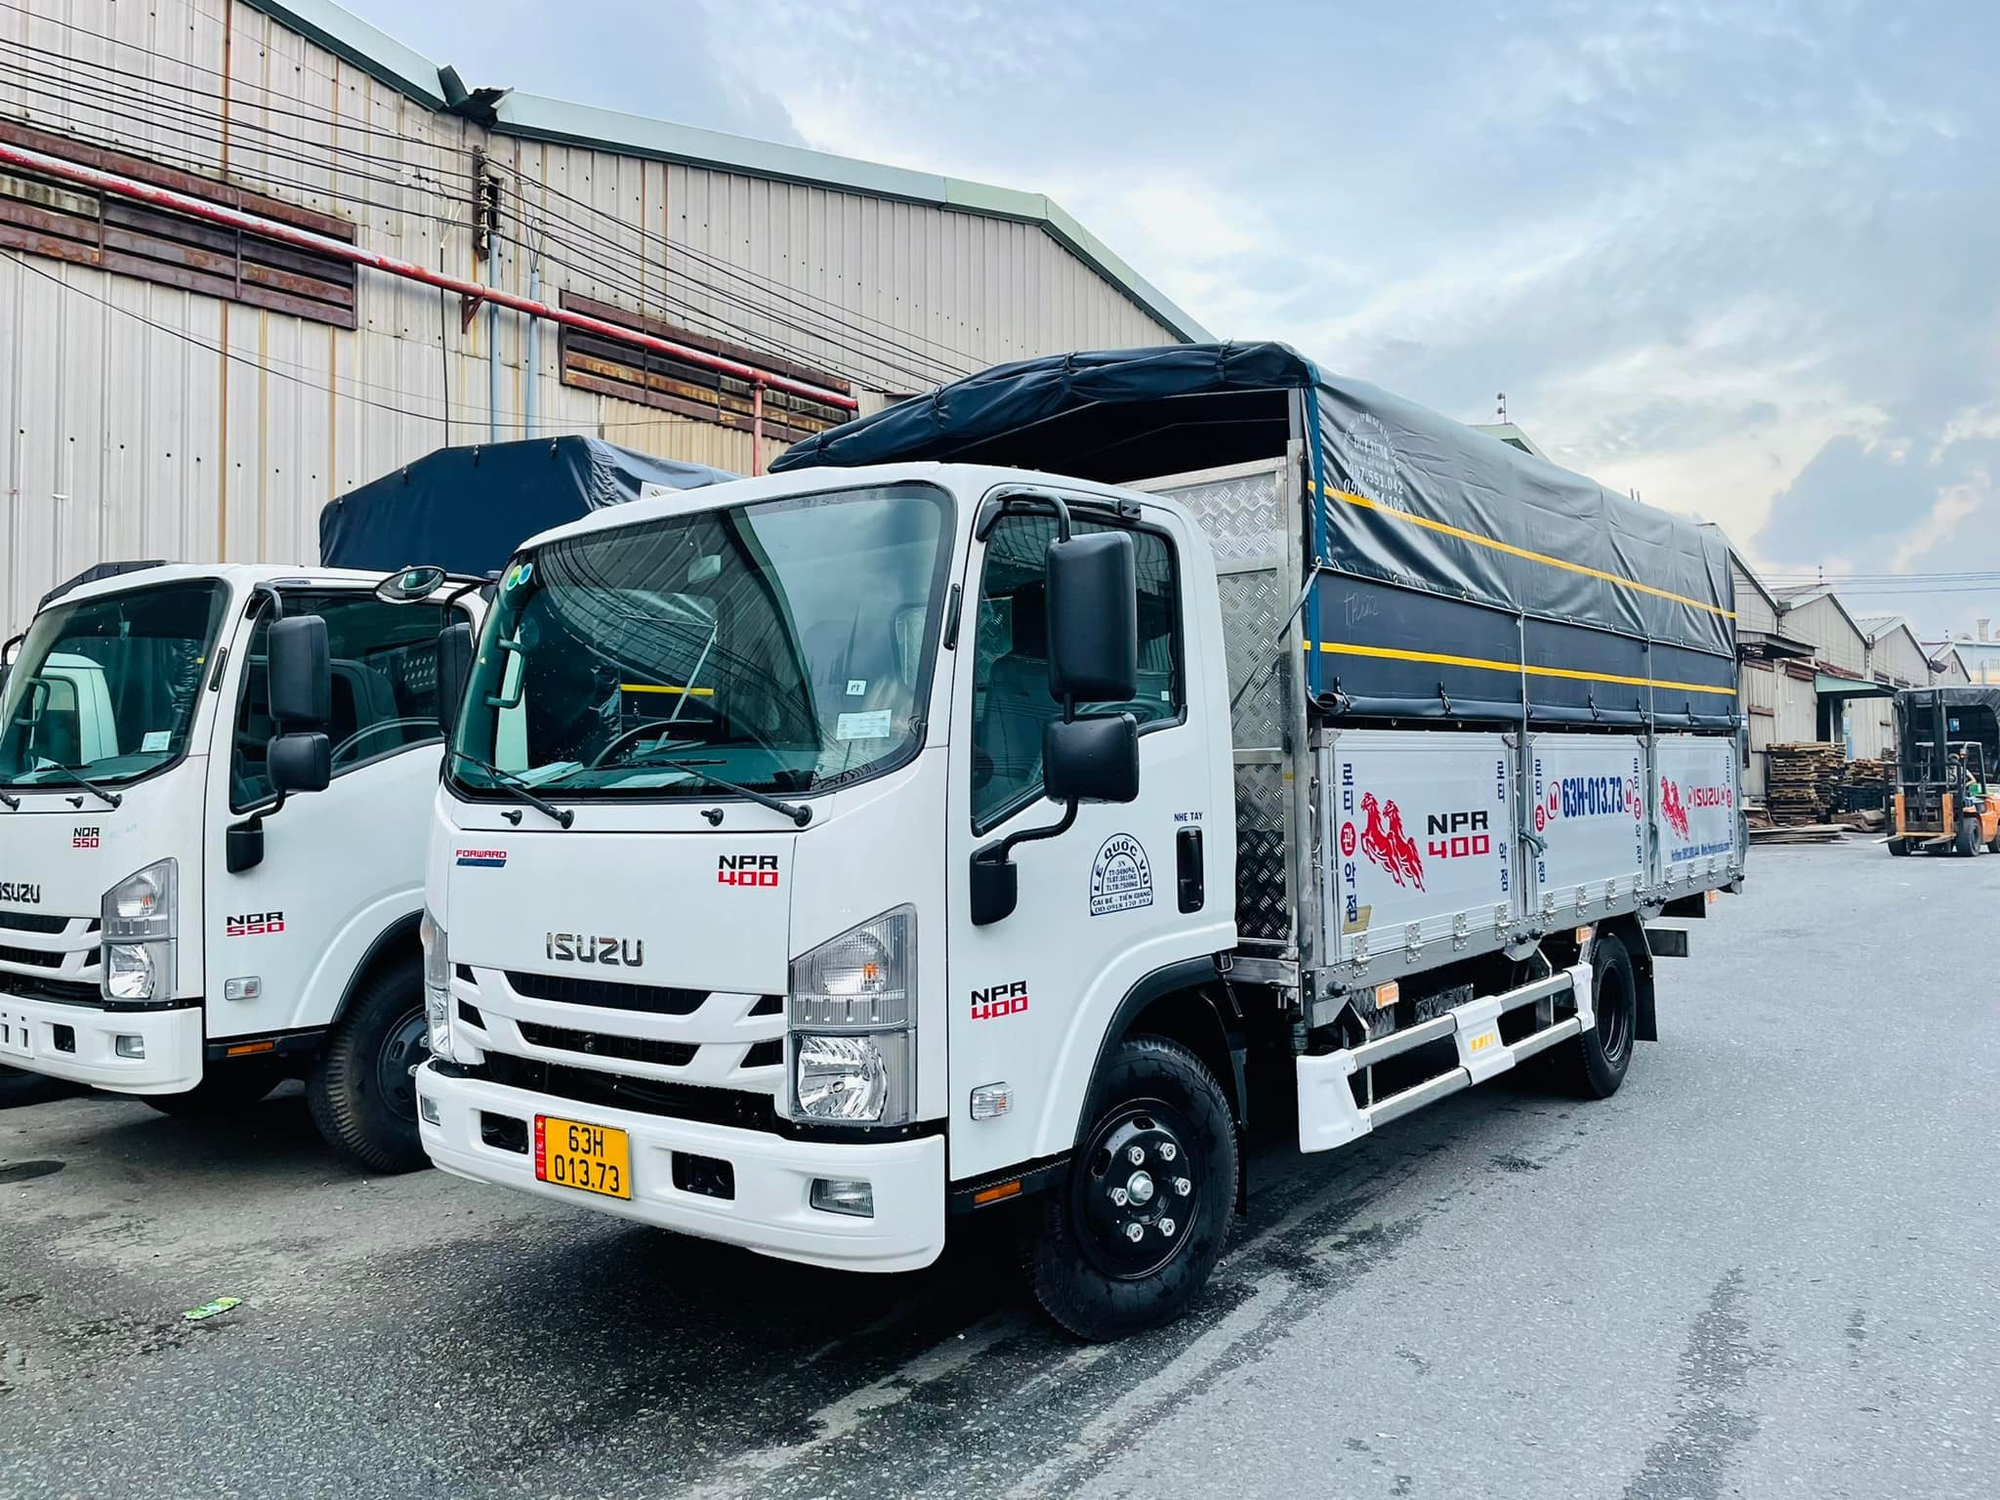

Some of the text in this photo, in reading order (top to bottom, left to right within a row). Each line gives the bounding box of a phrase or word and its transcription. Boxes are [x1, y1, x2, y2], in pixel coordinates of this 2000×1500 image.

[1693, 788, 1720, 807] ISUZU
[1190, 811, 1203, 821] TAY
[1427, 810, 1488, 836] NPR
[73, 827, 100, 837] NQR
[72, 837, 100, 848] 550
[1427, 834, 1490, 859] 400
[455, 849, 507, 859] FORWARD
[718, 854, 778, 870] NPR
[718, 871, 779, 887] 400
[226, 911, 284, 926] NQR
[226, 921, 285, 937] 550
[546, 932, 644, 967] ISUZU
[971, 980, 1027, 1006] NPR
[971, 996, 1028, 1020] 400
[568, 1125, 604, 1158] 63H
[554, 1154, 620, 1193] 013.73
